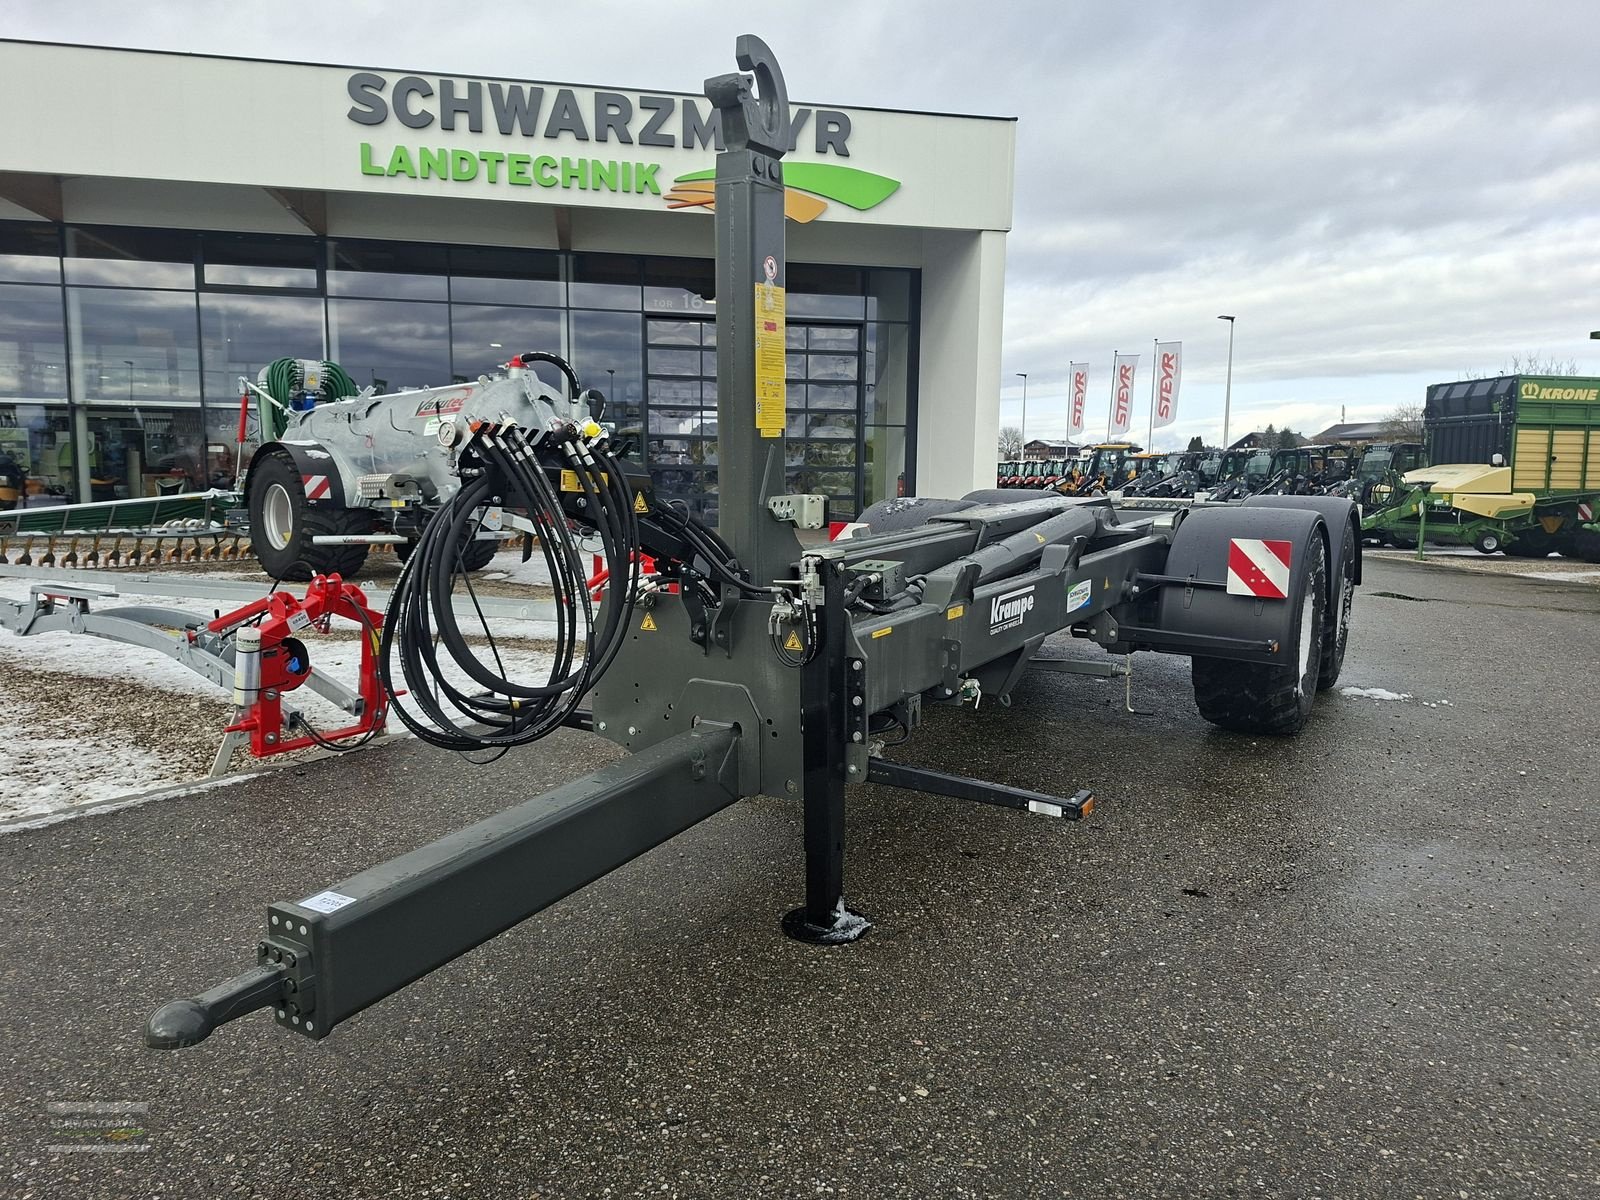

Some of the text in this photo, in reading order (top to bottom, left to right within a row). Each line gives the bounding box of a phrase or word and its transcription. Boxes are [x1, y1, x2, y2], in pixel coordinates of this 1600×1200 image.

[347, 72, 852, 158] SCHWARZMYR
[360, 142, 661, 195] LANDTECHNIK
[653, 299, 673, 308] TOR
[682, 293, 703, 309] 16
[415, 396, 465, 416] Vakutec
[1072, 371, 1085, 428] STEYR
[1115, 364, 1131, 427] STEYR
[1158, 352, 1174, 419] STEYR
[1539, 388, 1598, 400] KRONE
[990, 590, 1034, 624] Krampe
